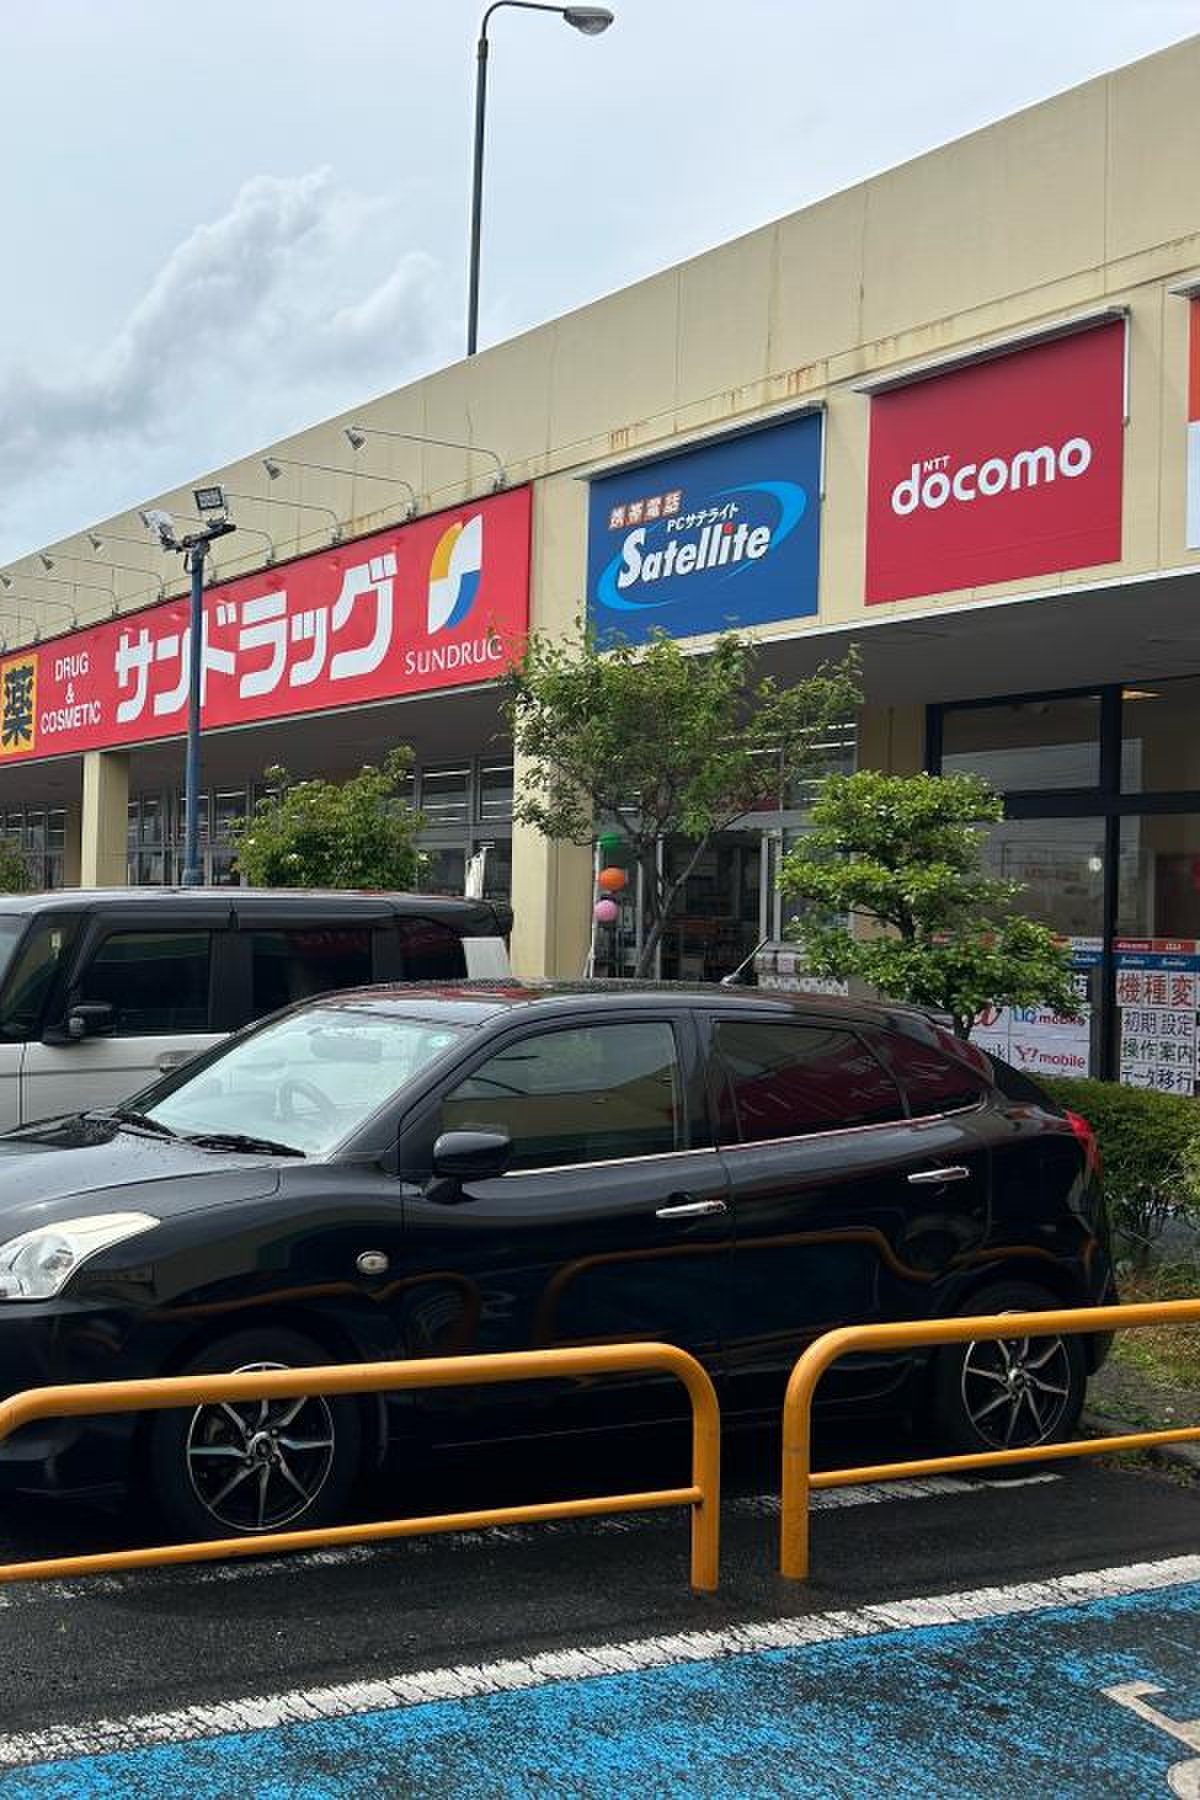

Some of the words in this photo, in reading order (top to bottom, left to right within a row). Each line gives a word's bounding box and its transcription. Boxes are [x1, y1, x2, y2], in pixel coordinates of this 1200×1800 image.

[891, 436, 1093, 516] docomo
[922, 455, 951, 475] NTT
[608, 489, 683, 530] 携帯電話
[666, 502, 740, 533] PCサテライト
[617, 521, 772, 589] Satellite
[114, 551, 399, 724] サンドラッグ
[403, 634, 505, 675] SUNDRUG
[54, 652, 89, 682] DRUG
[1, 664, 33, 747] 薬
[65, 684, 76, 704] &
[41, 702, 101, 735] COSMETIC
[1118, 972, 1200, 1007] 機種変
[1123, 1011, 1193, 1037] 初期設定
[1122, 1038, 1193, 1064] 操作案内
